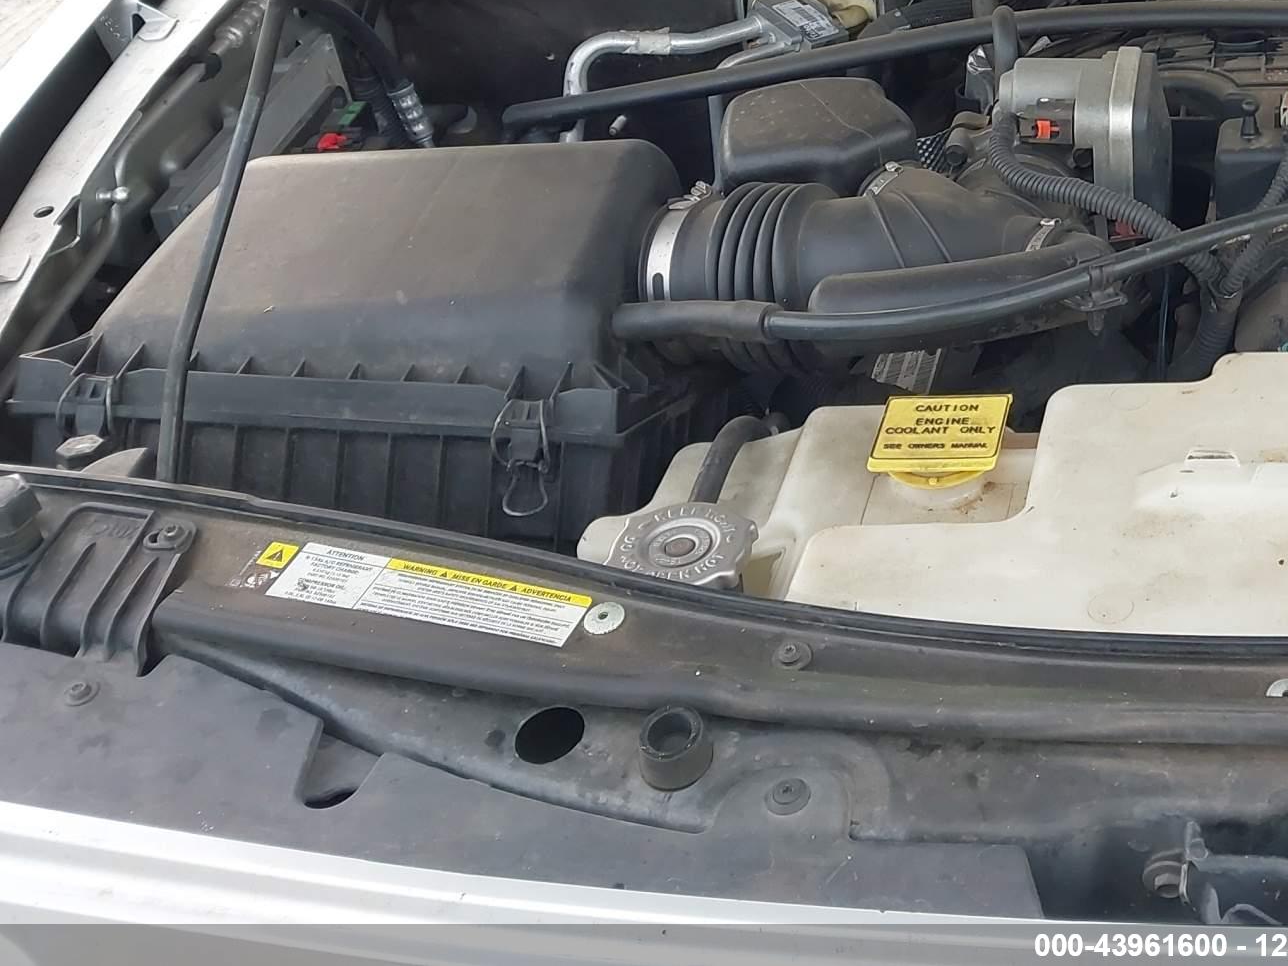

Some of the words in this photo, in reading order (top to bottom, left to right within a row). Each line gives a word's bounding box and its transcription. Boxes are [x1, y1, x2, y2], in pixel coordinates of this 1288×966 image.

[916, 404, 979, 412] CAUTION
[916, 417, 970, 426] ENGINE
[886, 426, 950, 434] COOLANT
[960, 426, 996, 434] ONLY
[326, 549, 365, 561] ATTENTION
[403, 564, 437, 576] WARNING
[452, 574, 470, 583] MISE
[481, 578, 507, 589] GARDE
[522, 588, 572, 602] ADVERTENCIA
